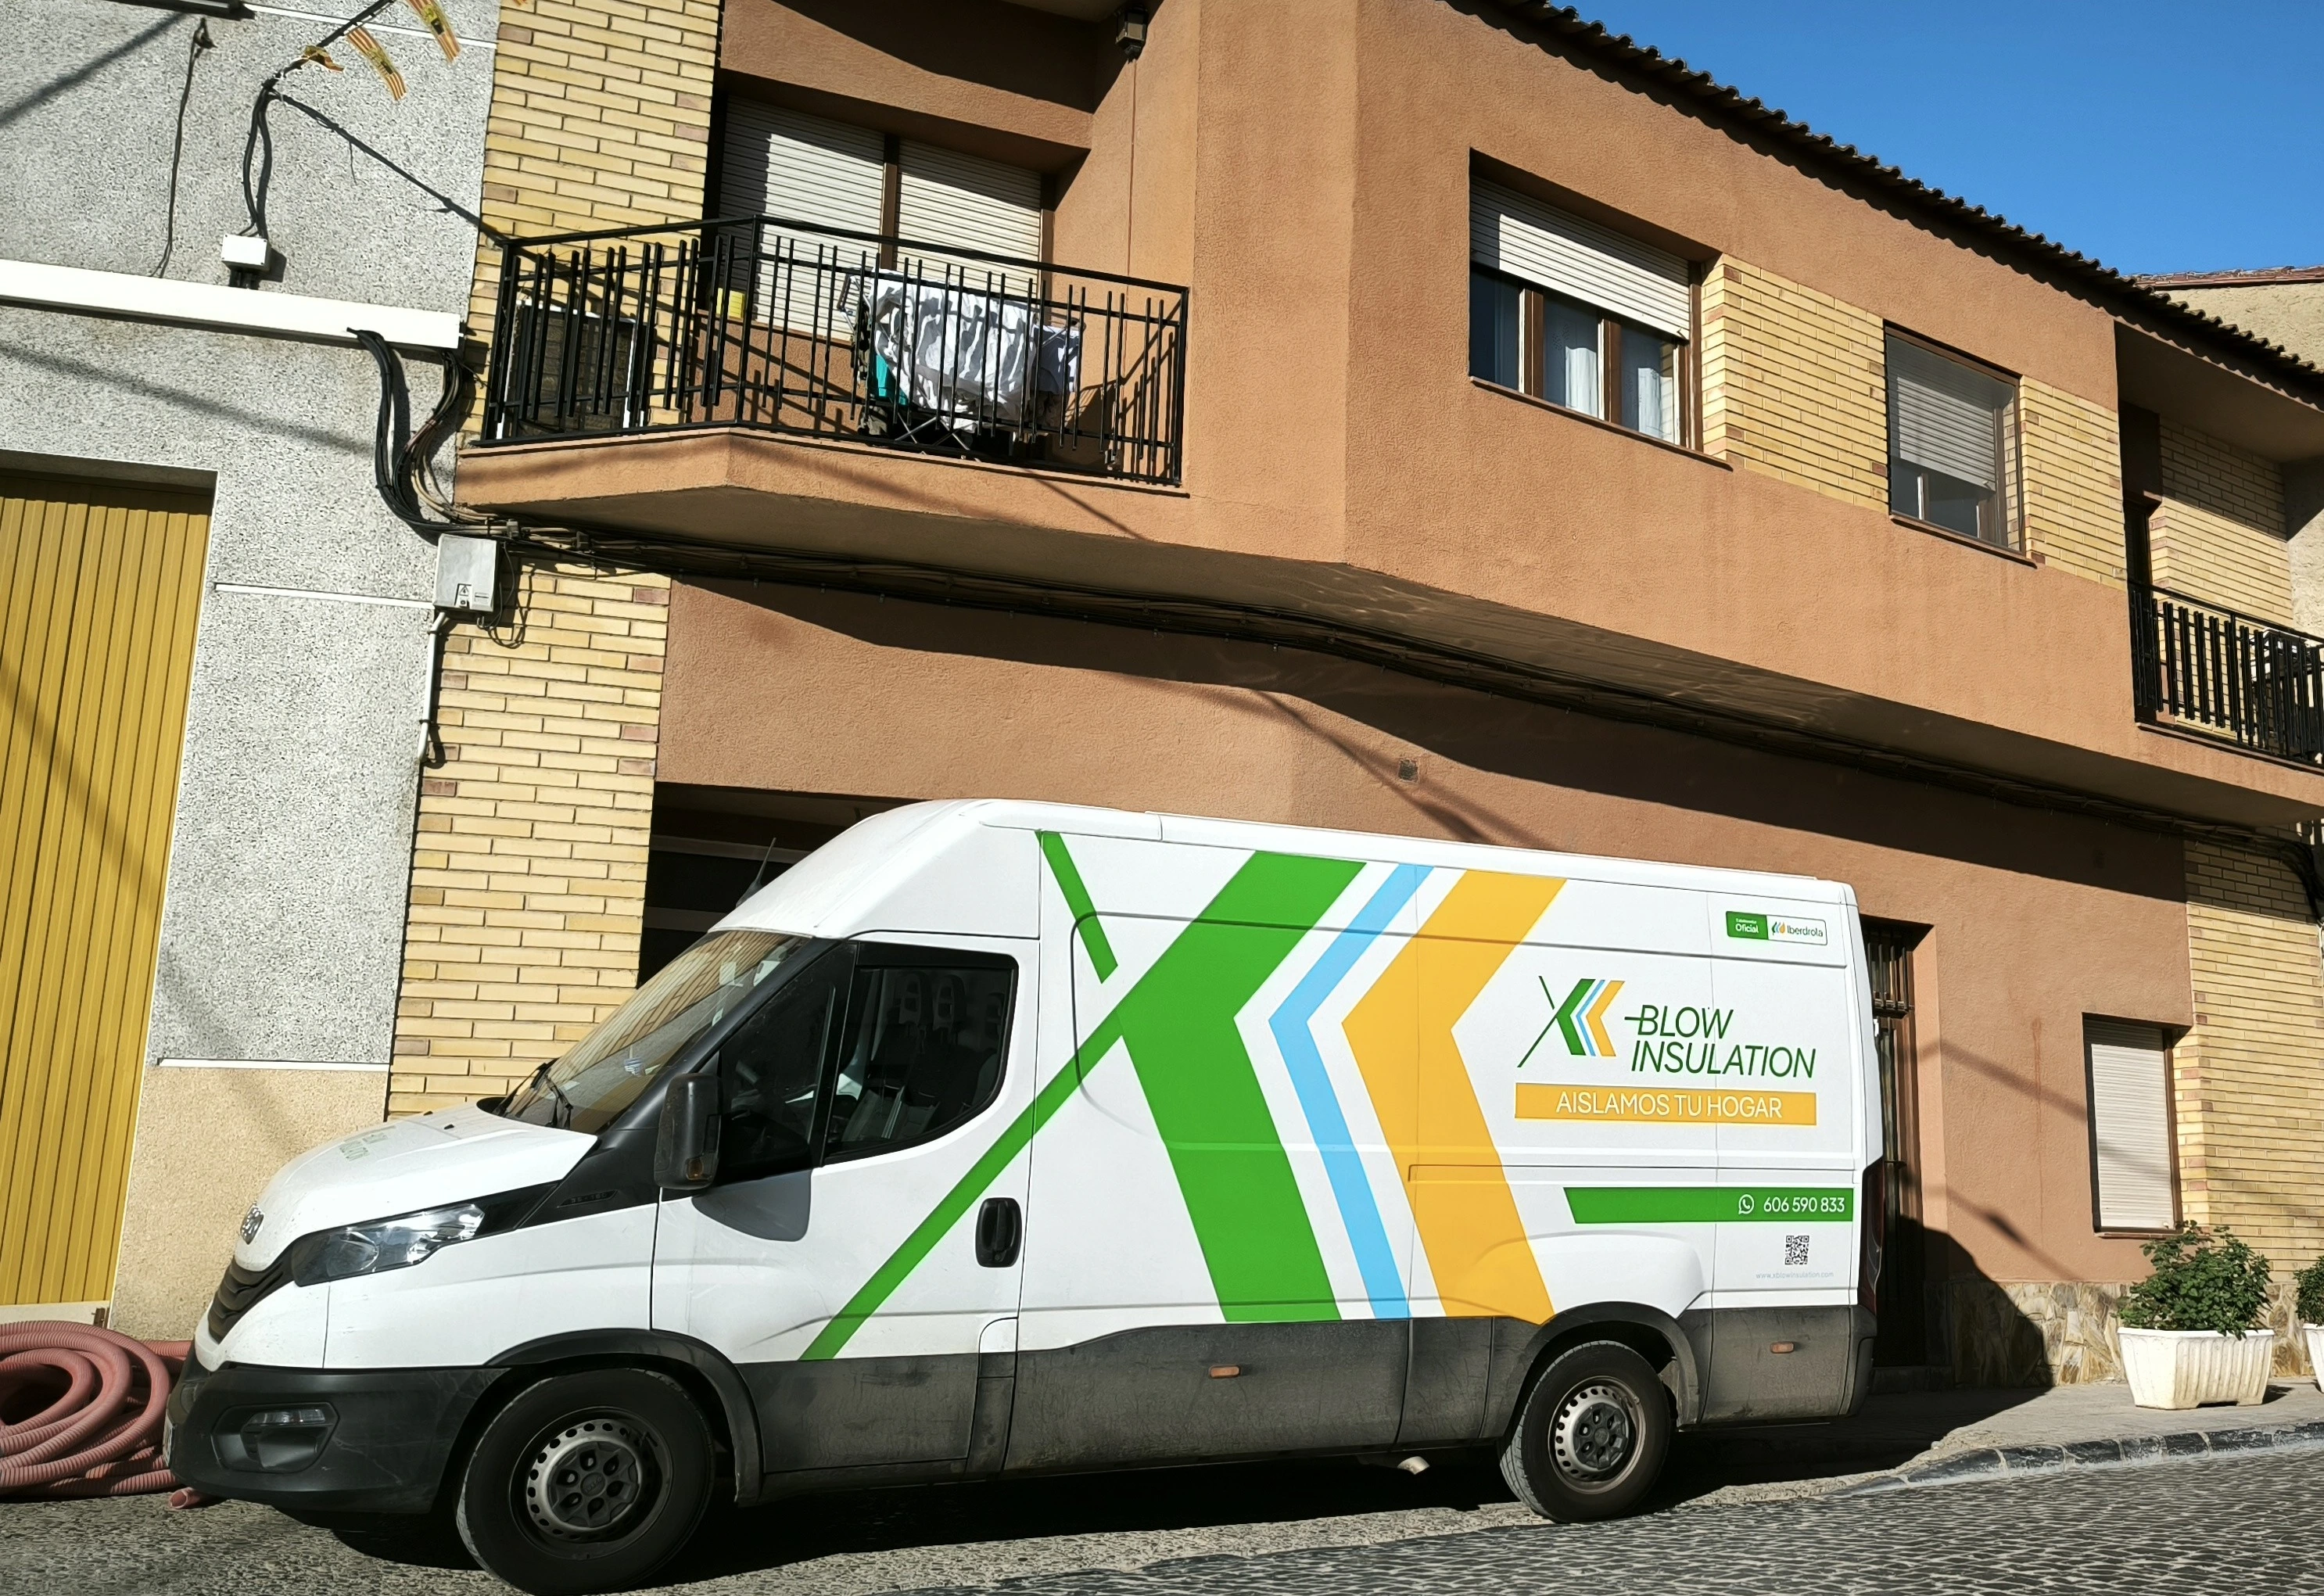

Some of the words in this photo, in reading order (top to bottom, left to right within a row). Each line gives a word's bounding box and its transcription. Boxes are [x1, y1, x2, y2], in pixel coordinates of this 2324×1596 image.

[1735, 923, 1759, 934] Oficial
[1787, 925, 1824, 937] Iberdrola
[1631, 1040, 1816, 1078] INSULATION
[1555, 1091, 1670, 1117] AISLAMOS
[1673, 1095, 1702, 1117] TU
[1707, 1095, 1783, 1118] HOGAR
[1763, 1196, 1789, 1212] 606
[1791, 1196, 1817, 1212] 590
[1820, 1197, 1845, 1212] 833
